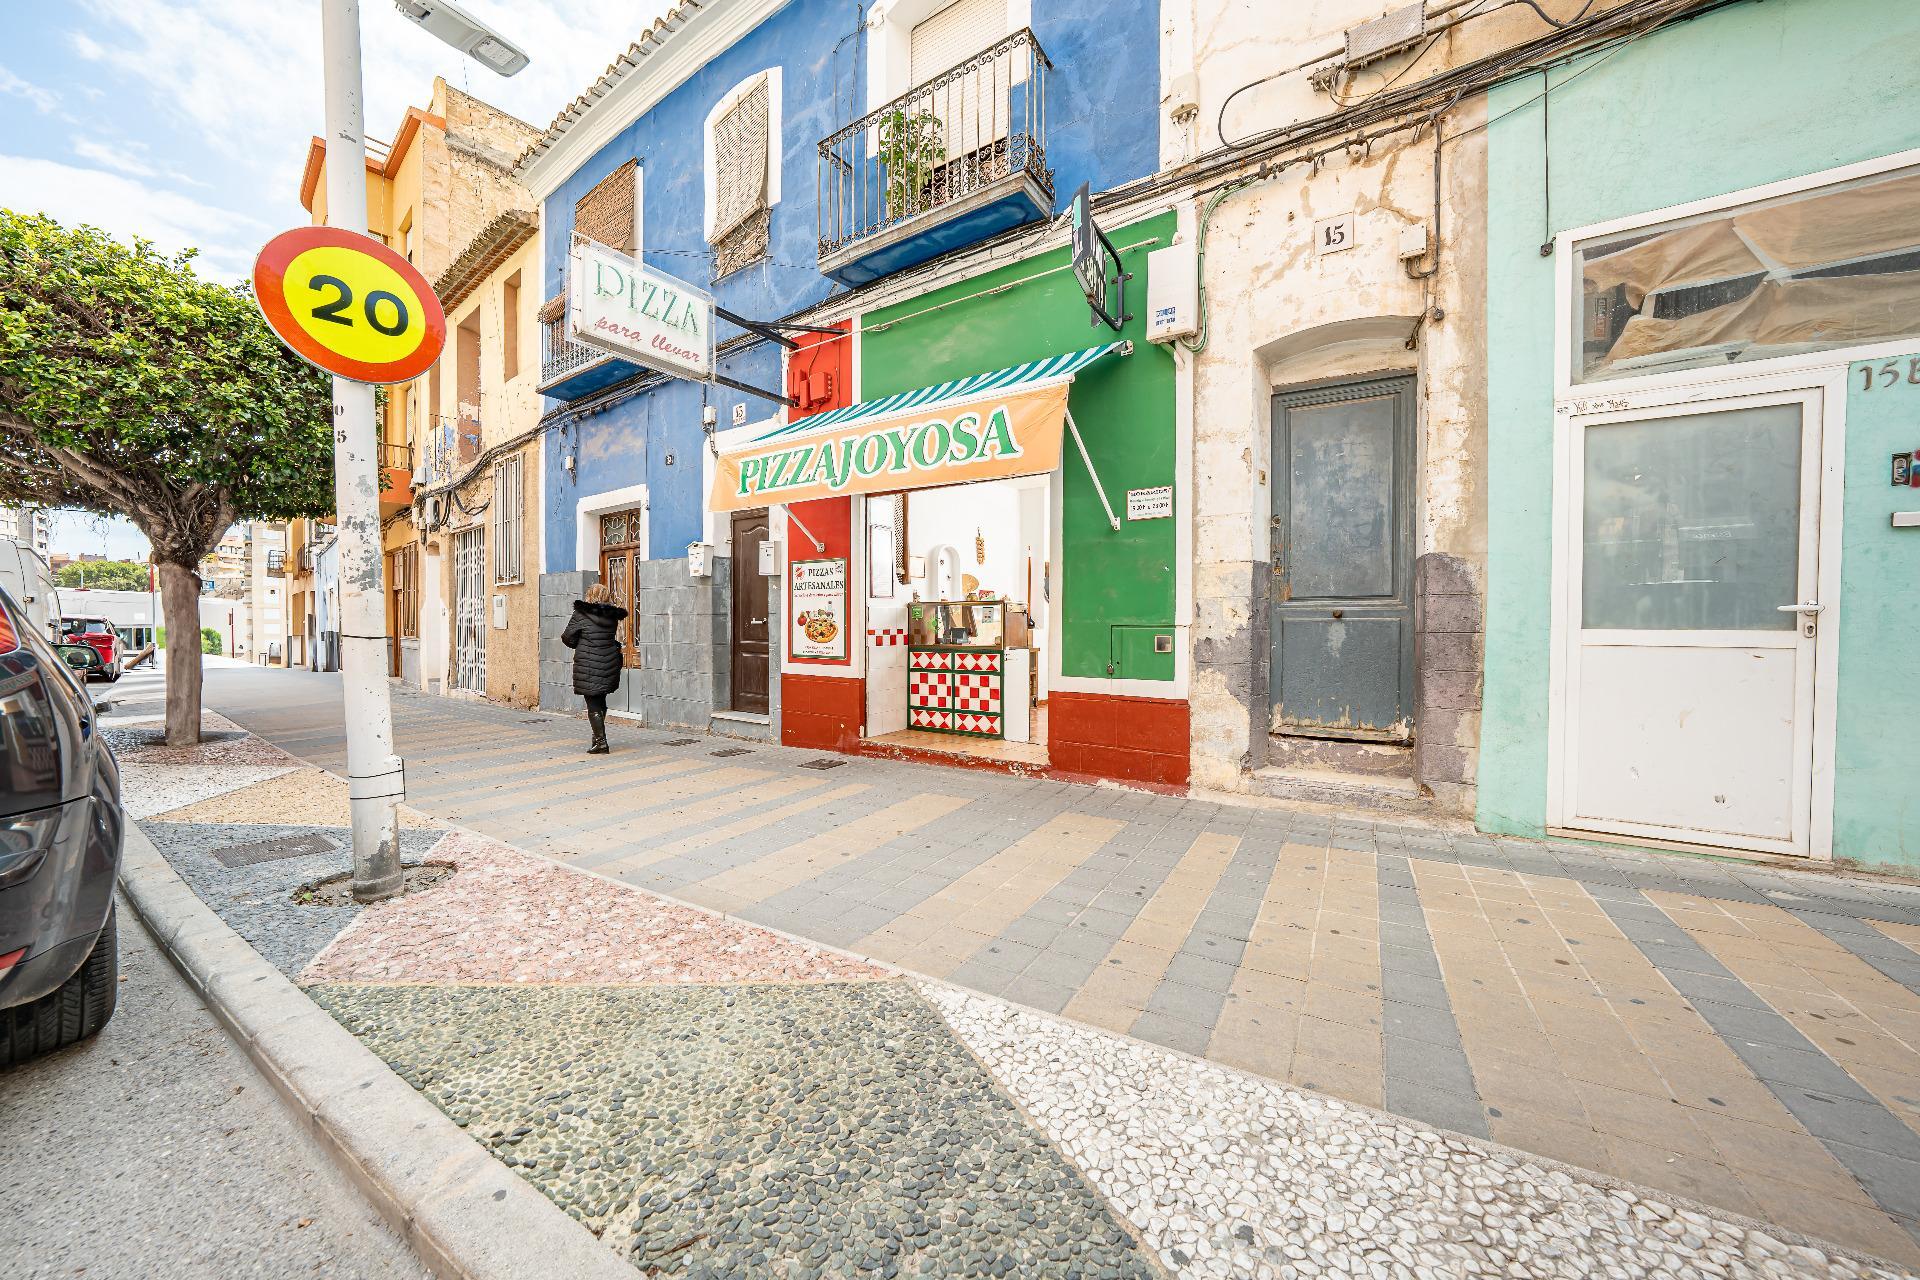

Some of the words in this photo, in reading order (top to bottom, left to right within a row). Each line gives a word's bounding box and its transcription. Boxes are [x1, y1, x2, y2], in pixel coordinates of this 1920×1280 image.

[1324, 223, 1345, 247] 15
[308, 274, 409, 336] 20
[593, 259, 700, 337] PIZZA
[594, 316, 641, 342] para
[651, 334, 700, 364] llevar
[794, 580, 844, 591] ARTESANALES
[808, 567, 834, 577] PIZZAS
